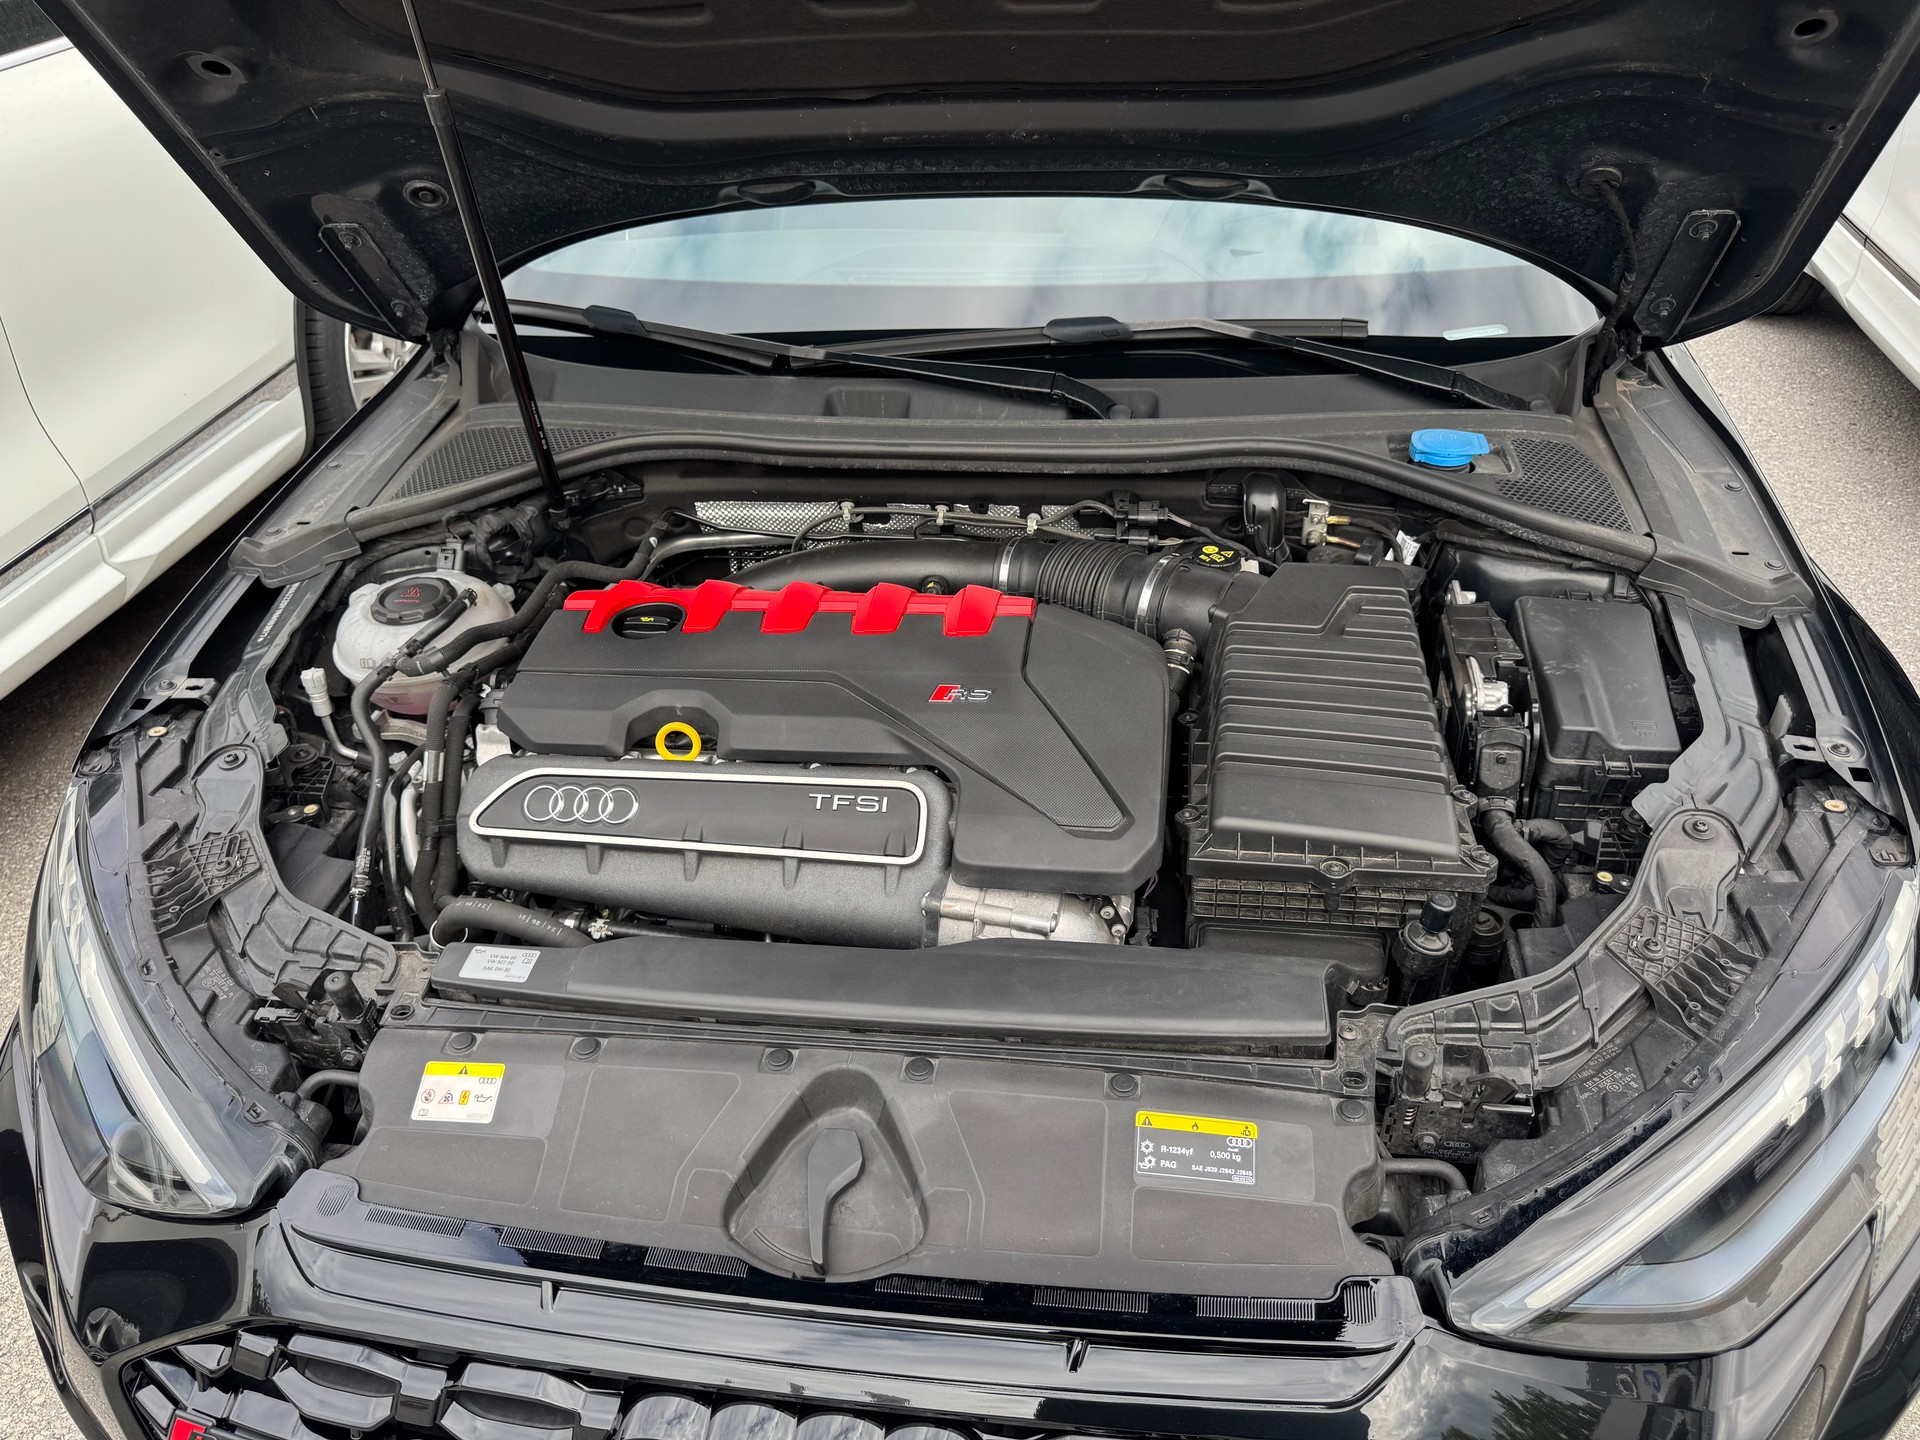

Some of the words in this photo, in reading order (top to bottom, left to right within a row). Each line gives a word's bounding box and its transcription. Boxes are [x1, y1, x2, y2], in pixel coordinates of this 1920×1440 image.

[937, 686, 991, 701] RS
[808, 793, 888, 813] TFSI
[1160, 1144, 1194, 1157] R-1234yf
[1209, 1150, 1231, 1160] 0,500
[1232, 1153, 1241, 1162] kg
[1160, 1159, 1177, 1169] PAG
[1191, 1164, 1204, 1172] SAE
